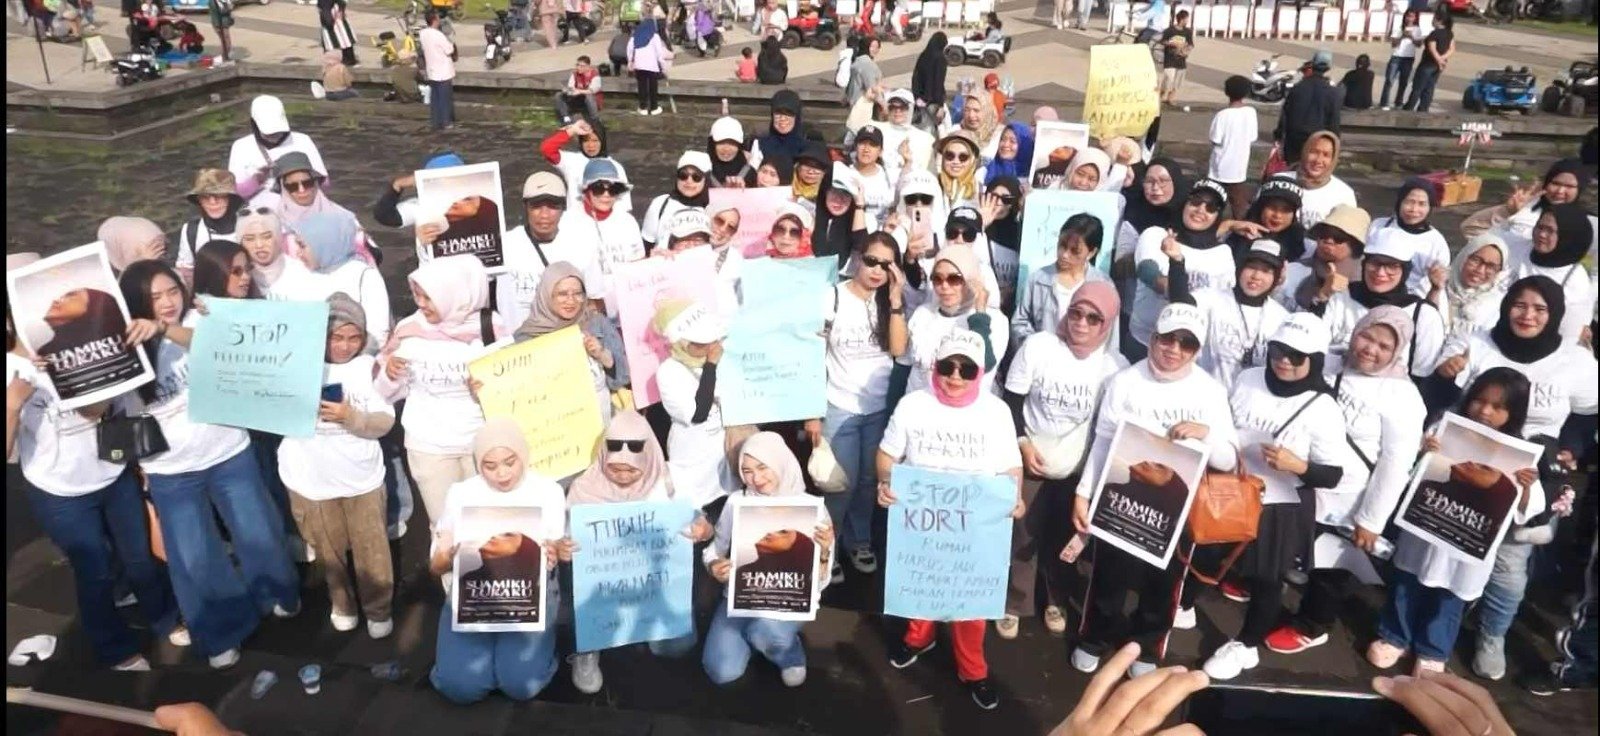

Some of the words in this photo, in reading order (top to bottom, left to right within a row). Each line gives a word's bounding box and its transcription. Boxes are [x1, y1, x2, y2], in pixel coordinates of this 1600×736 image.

[229, 322, 288, 346] STOP
[907, 479, 983, 508] STOP
[904, 507, 974, 532] KDRT
[466, 578, 533, 590] SUAMIKU
